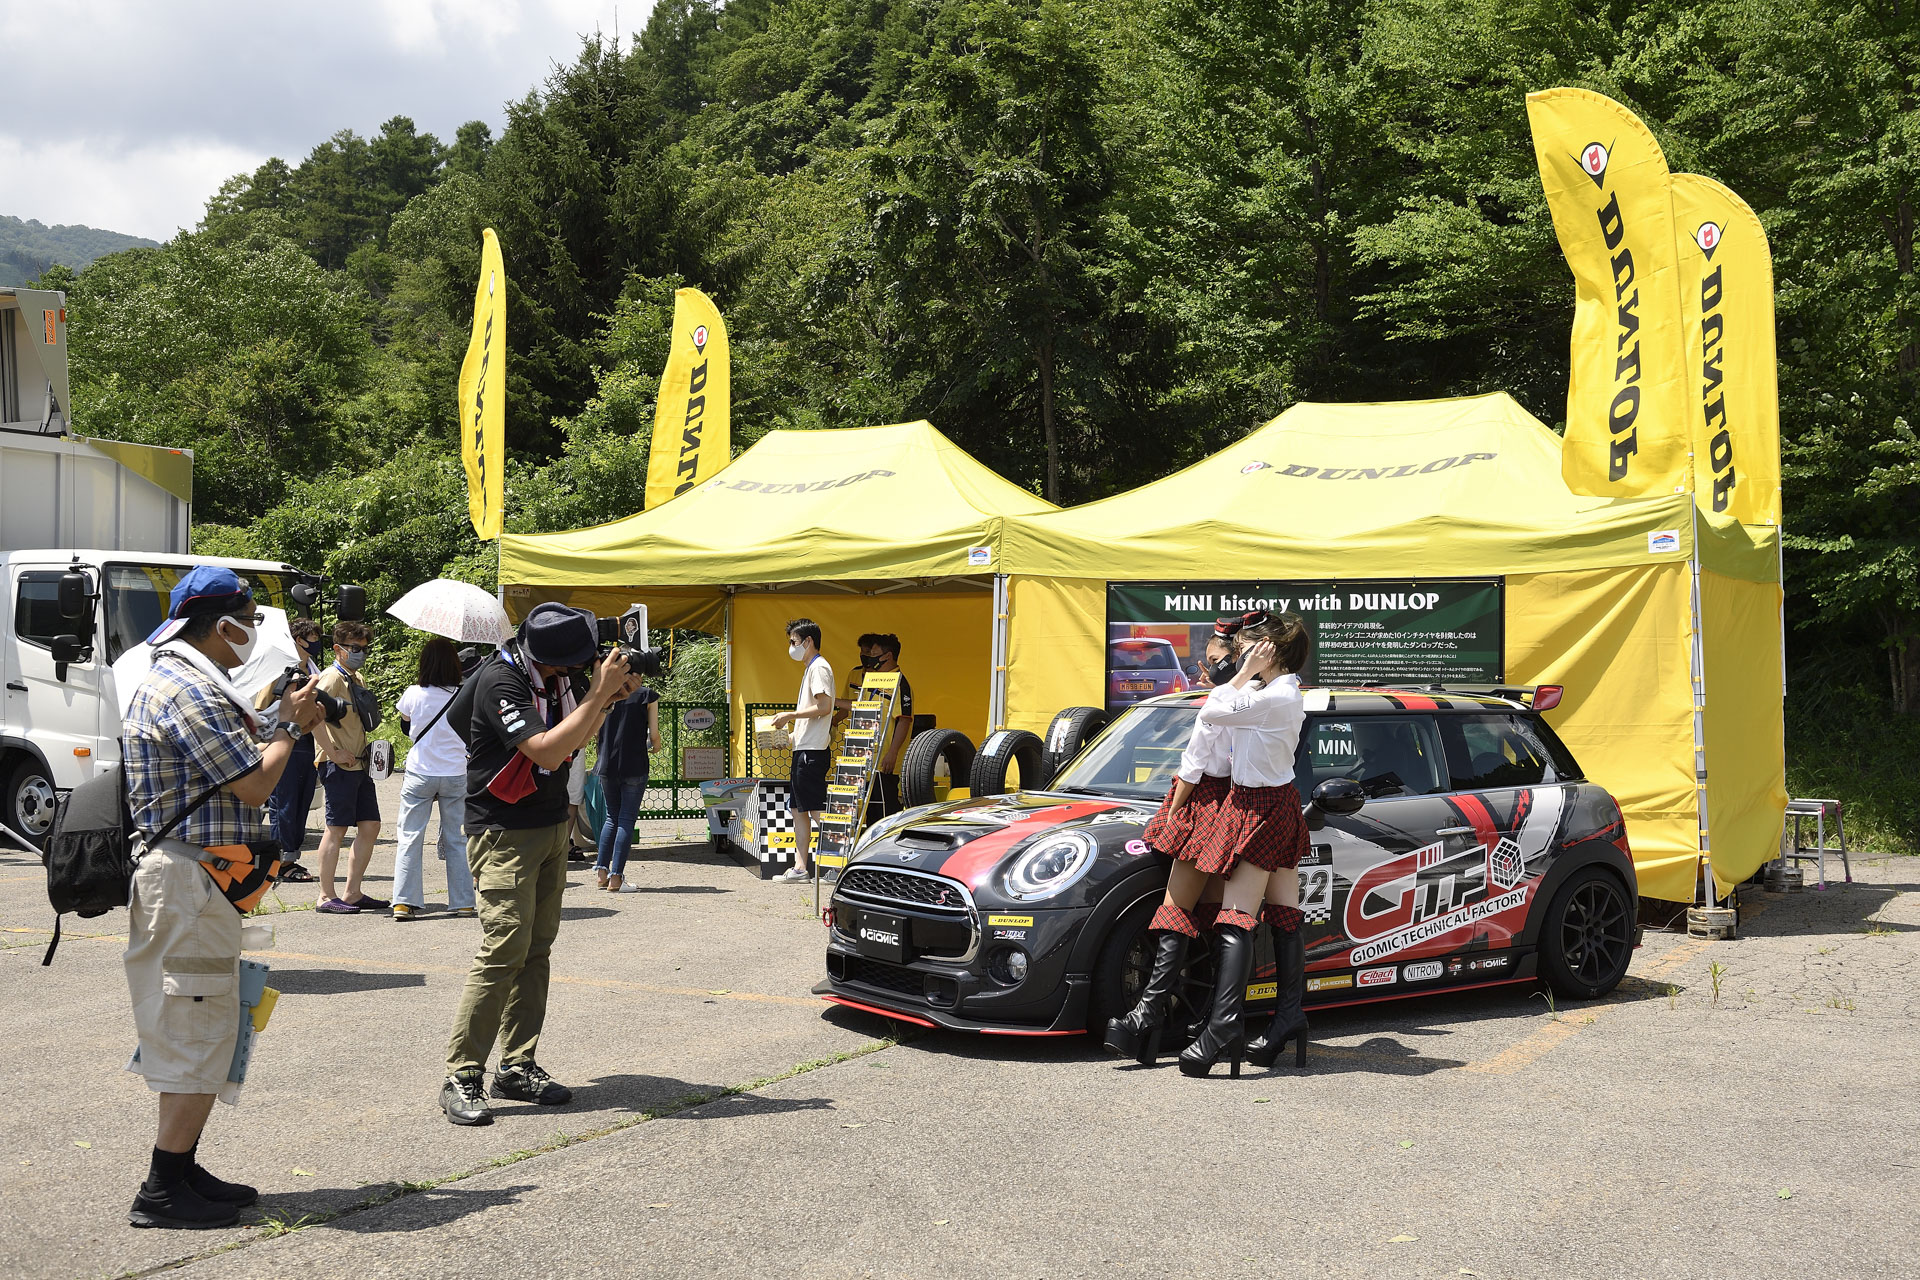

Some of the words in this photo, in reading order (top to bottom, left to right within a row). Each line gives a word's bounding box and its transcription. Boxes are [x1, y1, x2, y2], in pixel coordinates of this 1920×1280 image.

[1274, 452, 1498, 480] DUNLOP
[726, 469, 897, 494] DUNLOP
[1164, 594, 1213, 611] MINI
[1220, 594, 1291, 614] history
[1298, 593, 1342, 611] with
[1349, 592, 1440, 611] DUNLOP
[1352, 936, 1402, 963] GIOMIC
[1401, 912, 1469, 947] TECHNICAL
[1472, 891, 1526, 918] FACTORY
[866, 931, 900, 946] GIOMIC
[1359, 968, 1394, 984] Eibach
[1407, 964, 1438, 979] NITRON
[1256, 986, 1278, 995] DUN
